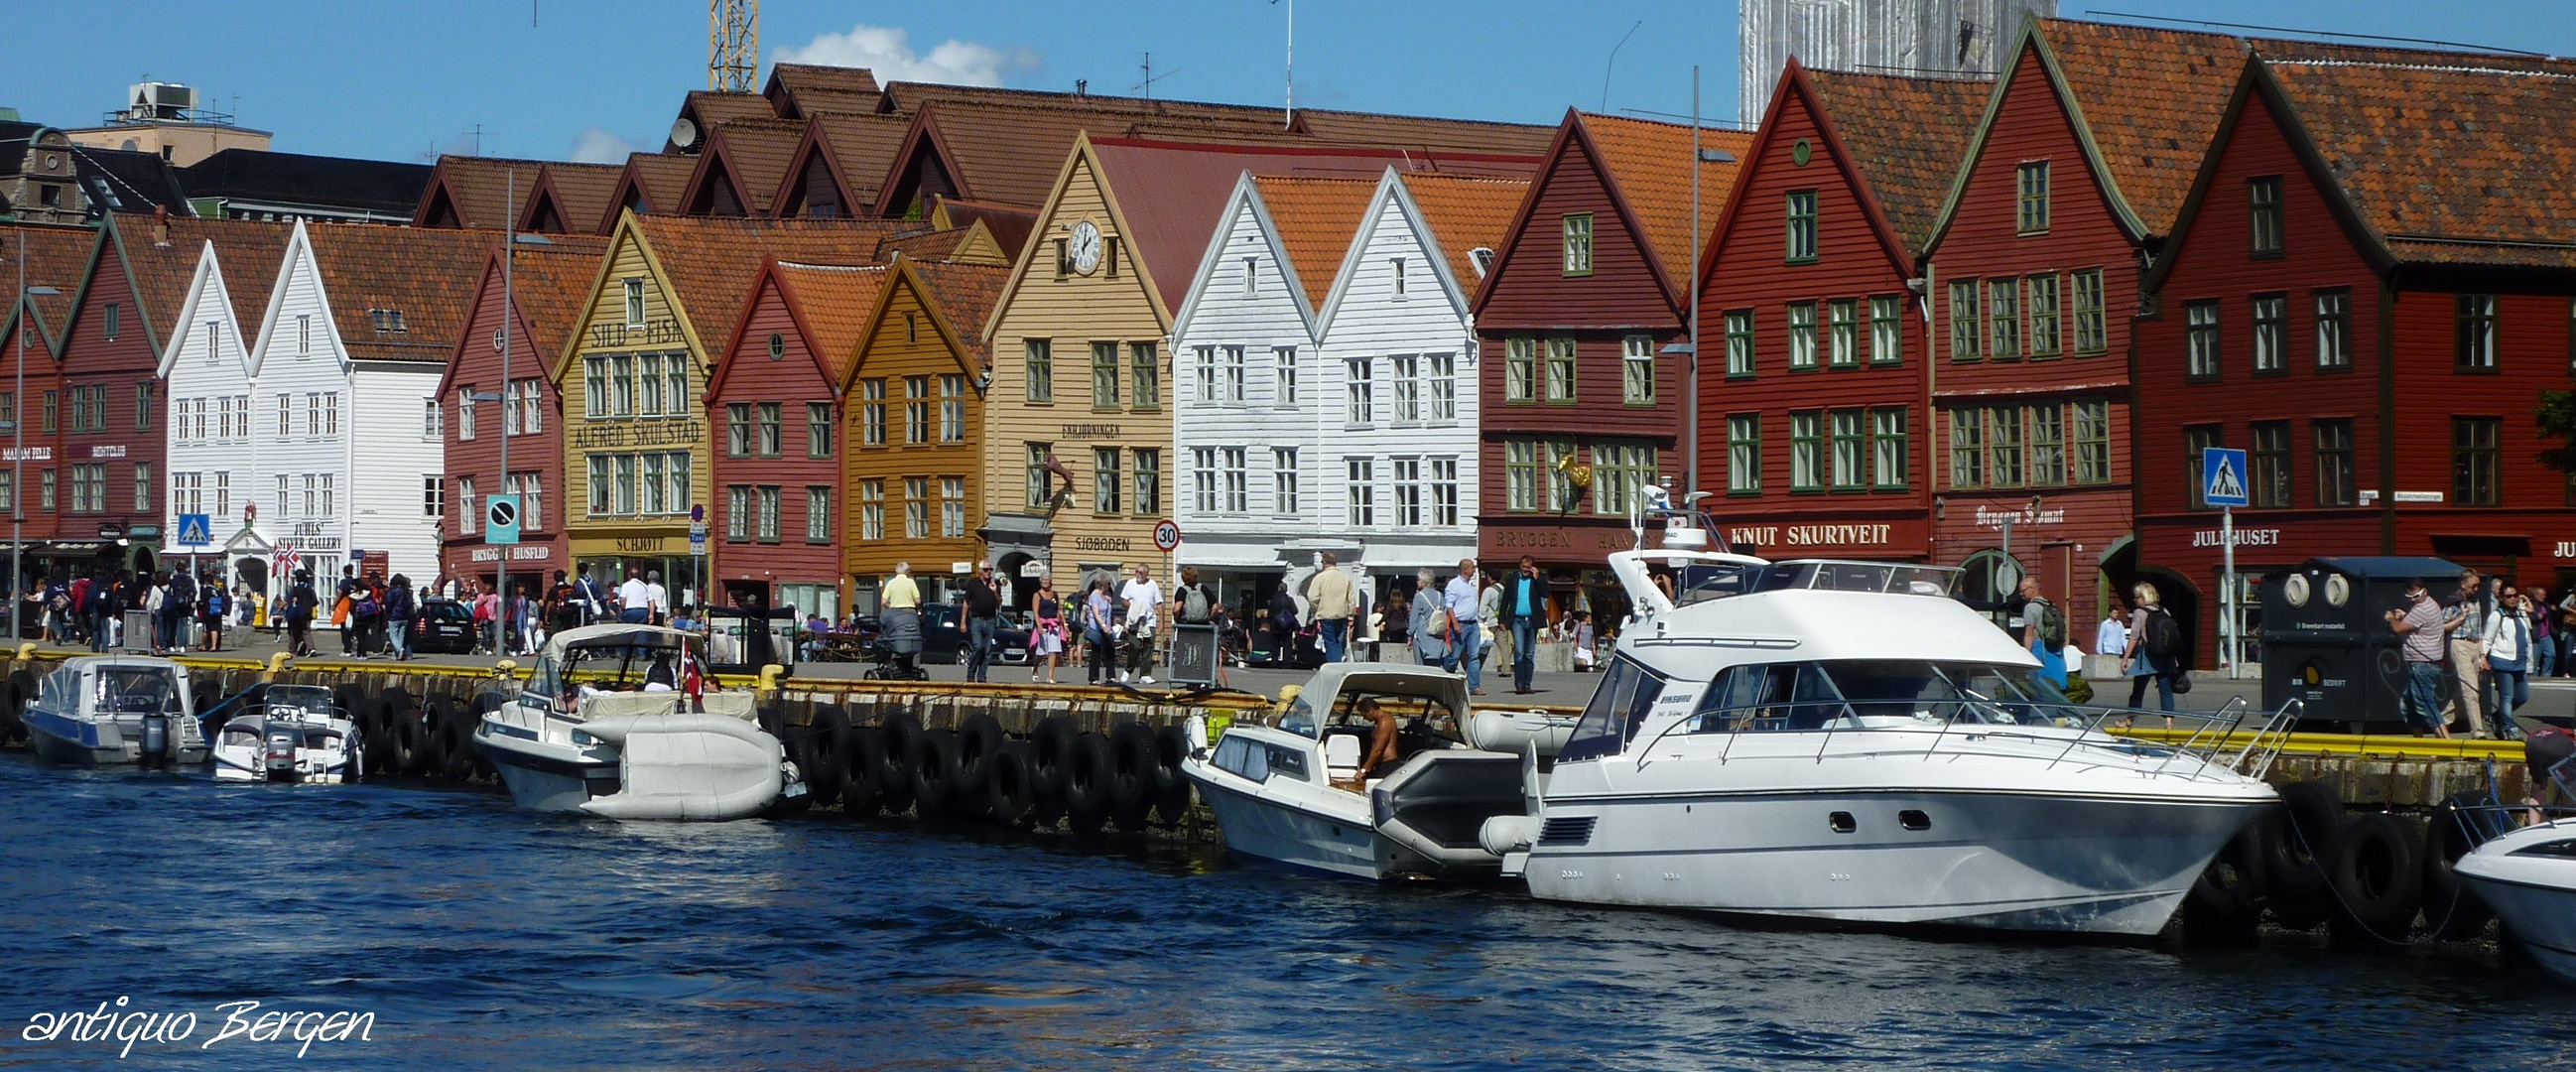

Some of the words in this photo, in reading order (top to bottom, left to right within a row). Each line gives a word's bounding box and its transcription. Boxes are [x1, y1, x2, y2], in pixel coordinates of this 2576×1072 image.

[590, 323, 627, 348] SILD
[575, 425, 625, 449] ALFRED
[632, 421, 701, 447] SKULSTAD
[2, 447, 31, 461] MAAM
[1158, 527, 1176, 544] 30
[1495, 531, 1571, 548] BRYGGEN
[1731, 526, 1778, 546] KNUT
[1786, 524, 1890, 545] SKURTVEIT
[308, 537, 342, 550] GALLERY
[616, 536, 665, 552] SCHJØTT
[1075, 537, 1130, 552] SJØBODEN
[471, 548, 509, 562] BRYGG
[513, 547, 549, 560] HUSFLID
